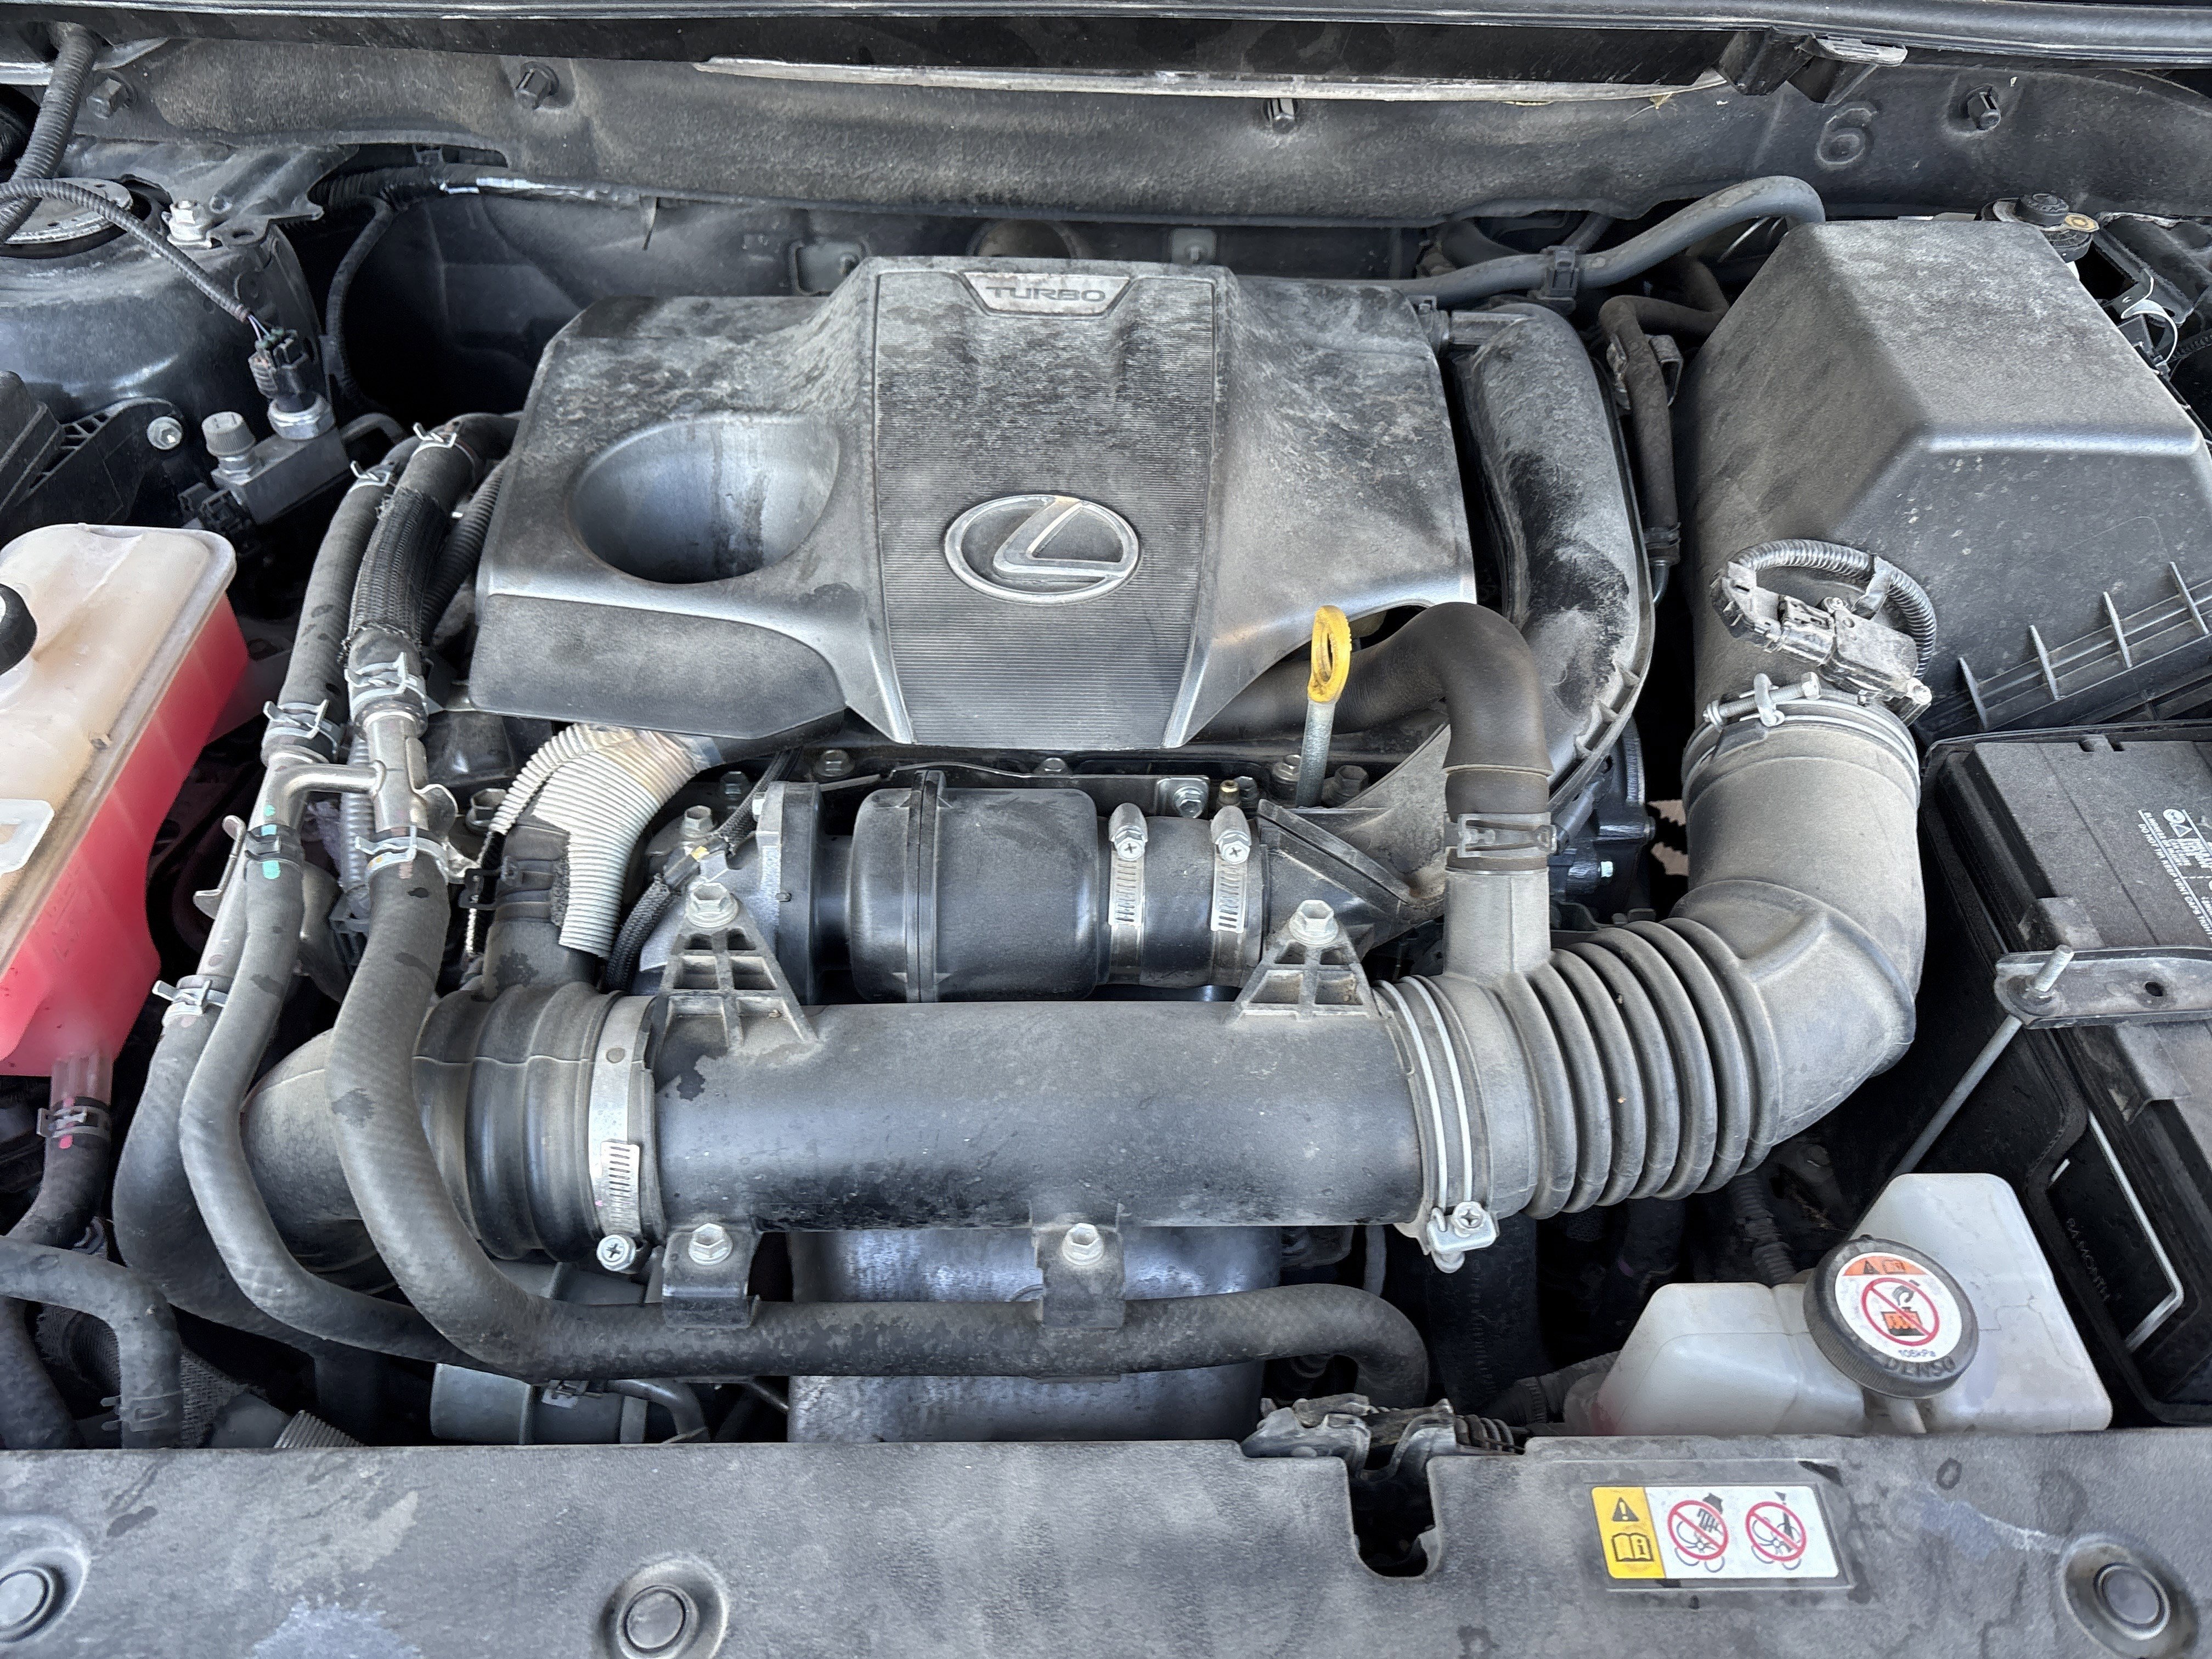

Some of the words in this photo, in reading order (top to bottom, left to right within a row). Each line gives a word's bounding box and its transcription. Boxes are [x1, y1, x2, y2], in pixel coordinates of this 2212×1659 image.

[985, 286, 1106, 302] TURBO
[2137, 823, 2150, 834] DO
[2144, 834, 2159, 848] NOT
[2173, 878, 2190, 895] VENT
